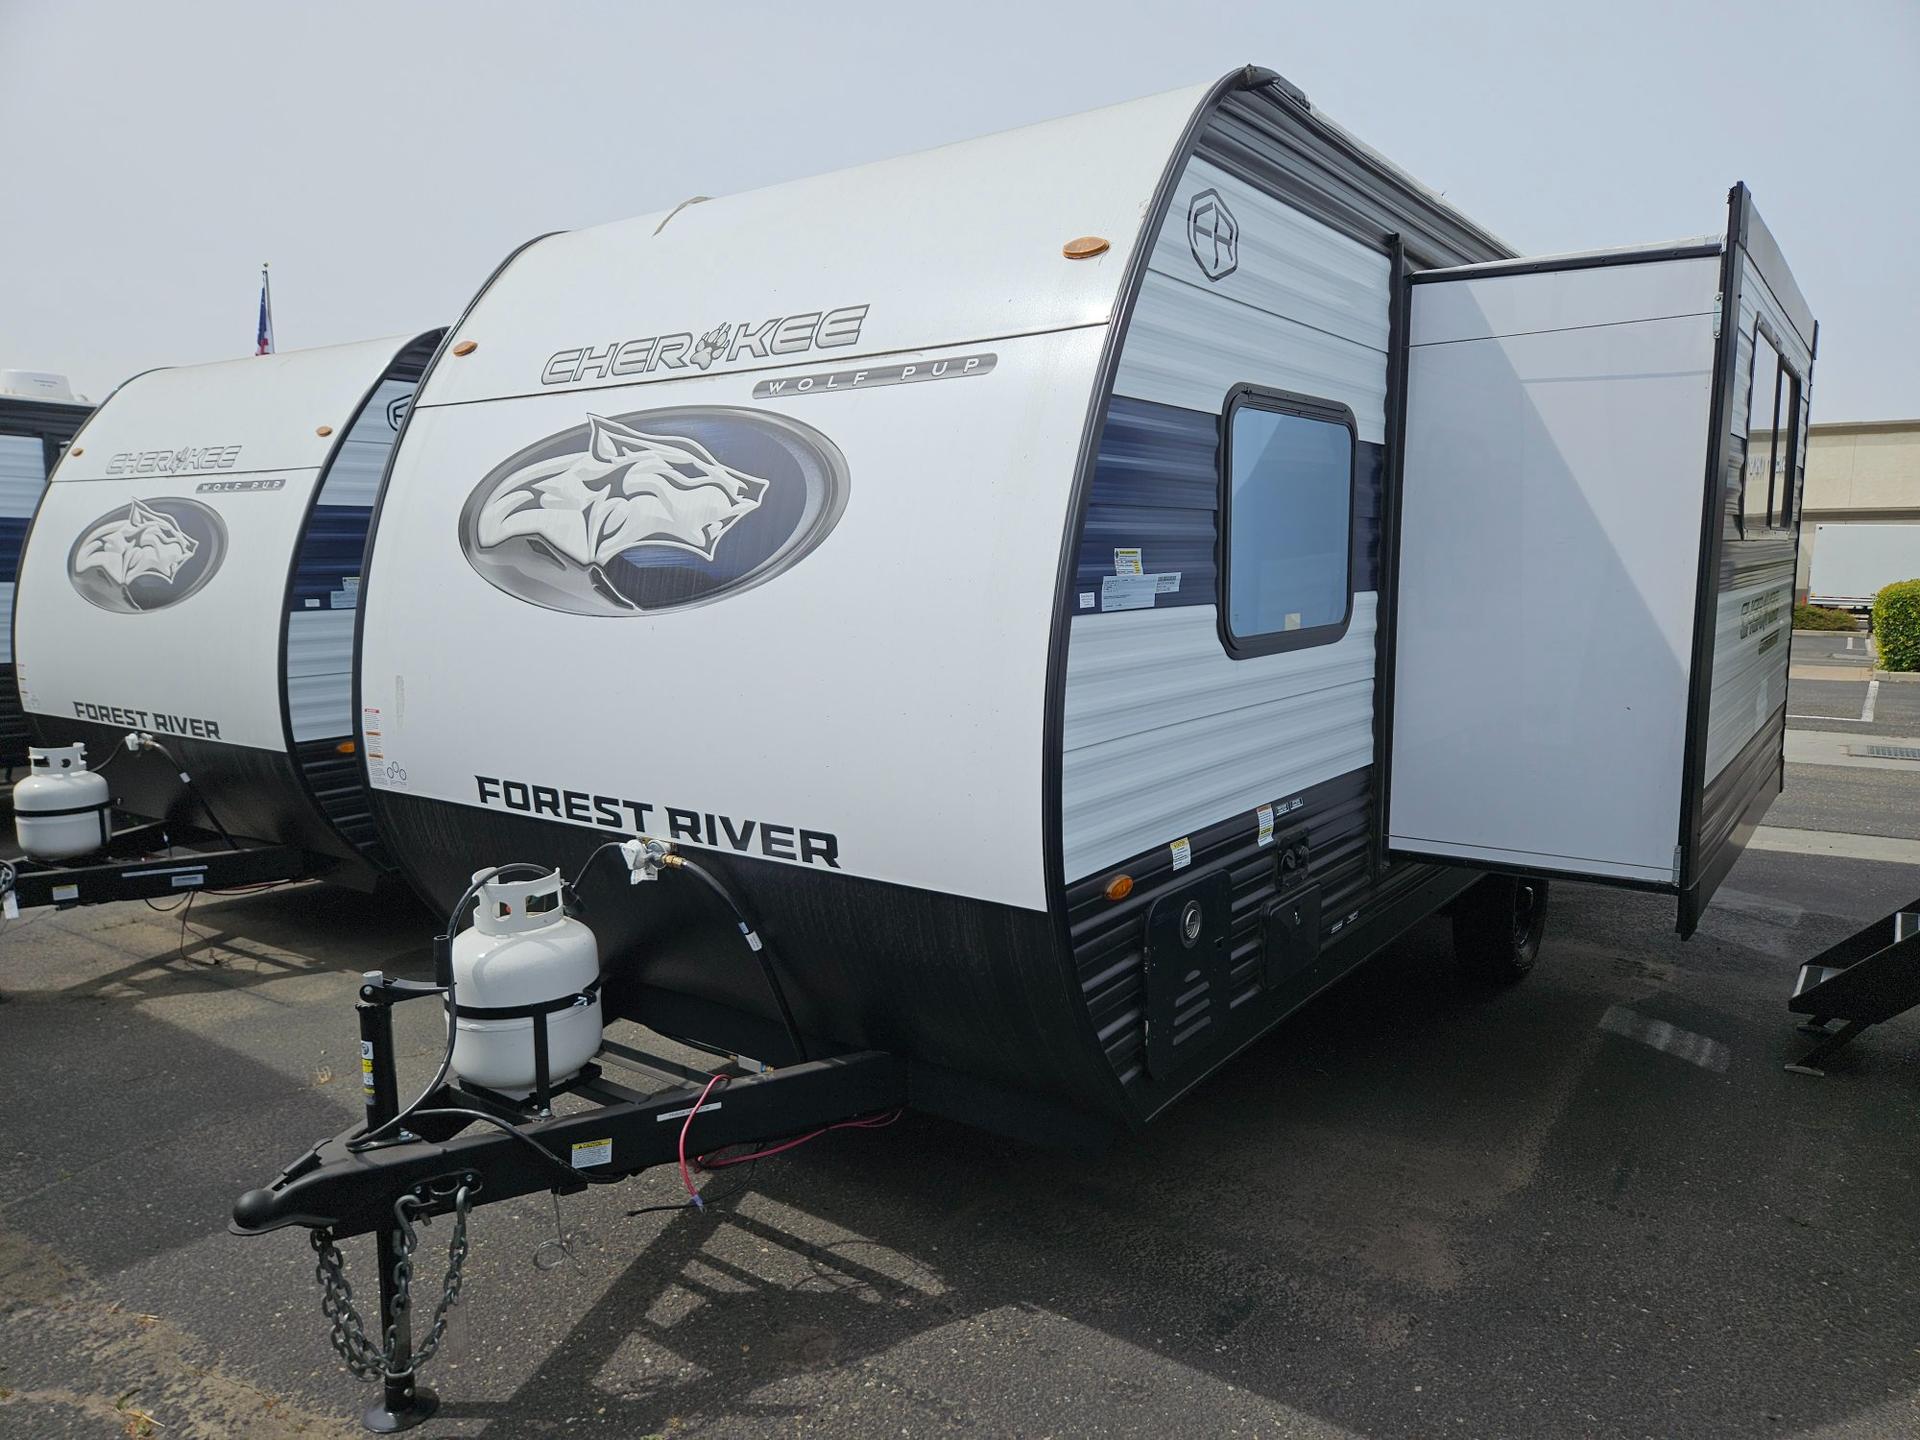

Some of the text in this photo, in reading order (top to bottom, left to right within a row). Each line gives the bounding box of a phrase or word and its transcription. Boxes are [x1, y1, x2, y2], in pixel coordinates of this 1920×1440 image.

[766, 357, 981, 394] WOLF PUP
[202, 480, 282, 492] WOLF PUP
[73, 701, 221, 741] FOREST RIVER
[474, 775, 841, 869] FOREST RIVER
